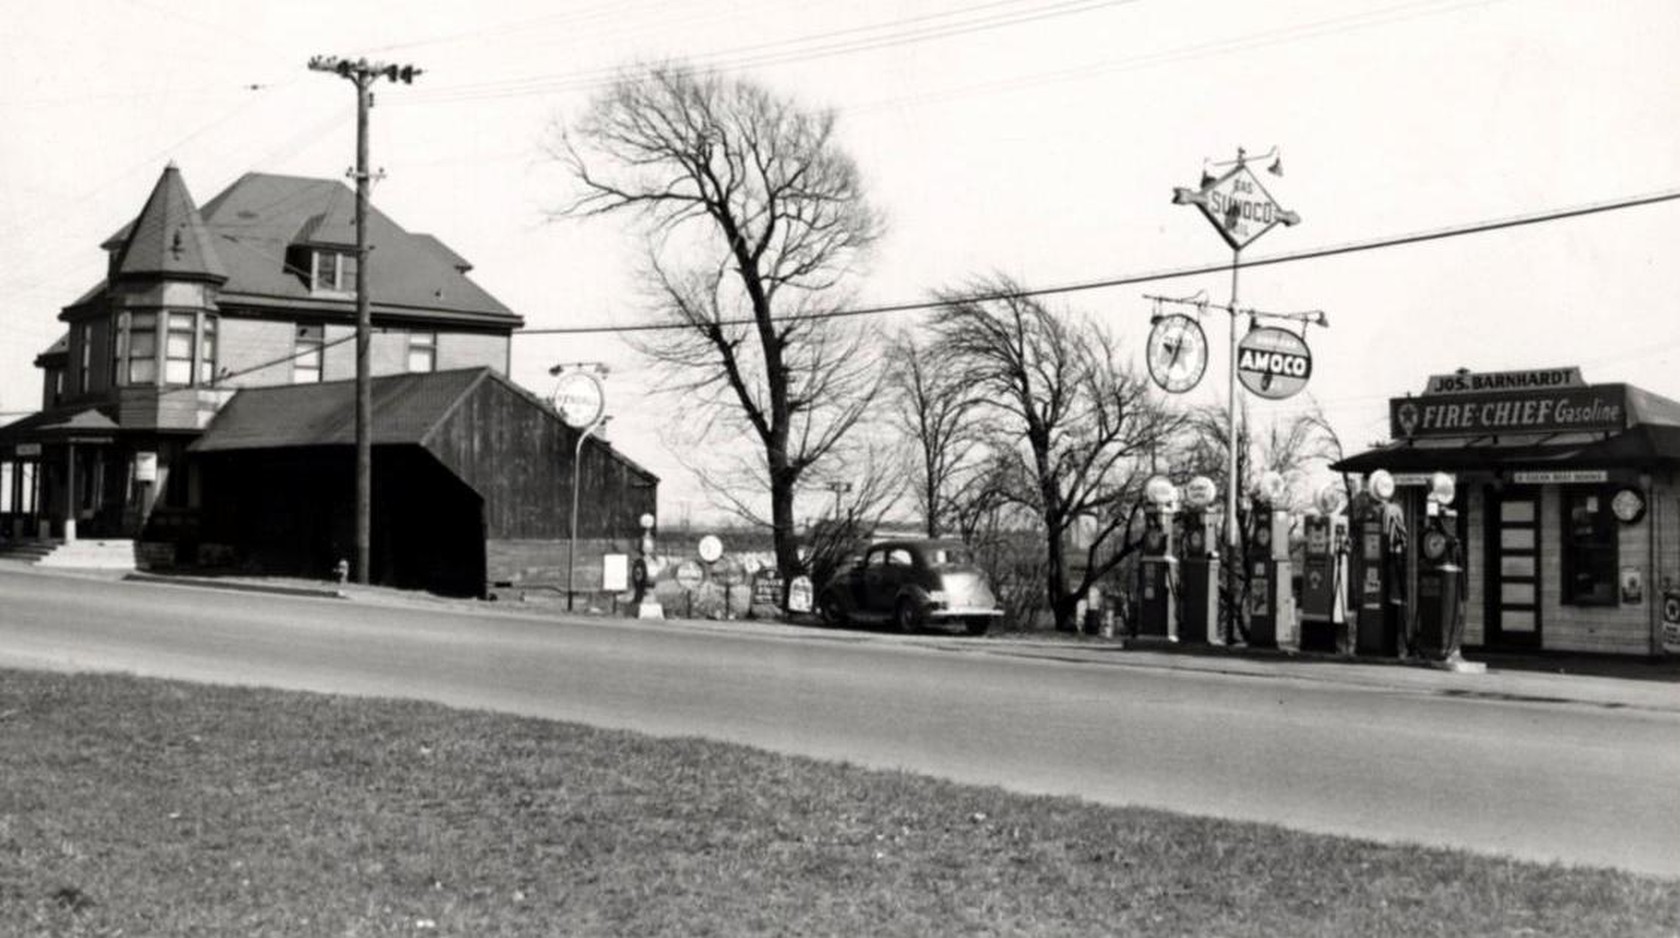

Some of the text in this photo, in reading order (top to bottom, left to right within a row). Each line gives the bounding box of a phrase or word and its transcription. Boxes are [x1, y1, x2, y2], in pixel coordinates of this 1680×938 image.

[1210, 190, 1273, 224] SUNOCO
[1240, 349, 1307, 377] AMOCO
[1434, 370, 1573, 393] JOS. BARNHARDT
[1554, 396, 1620, 424] Gasoline
